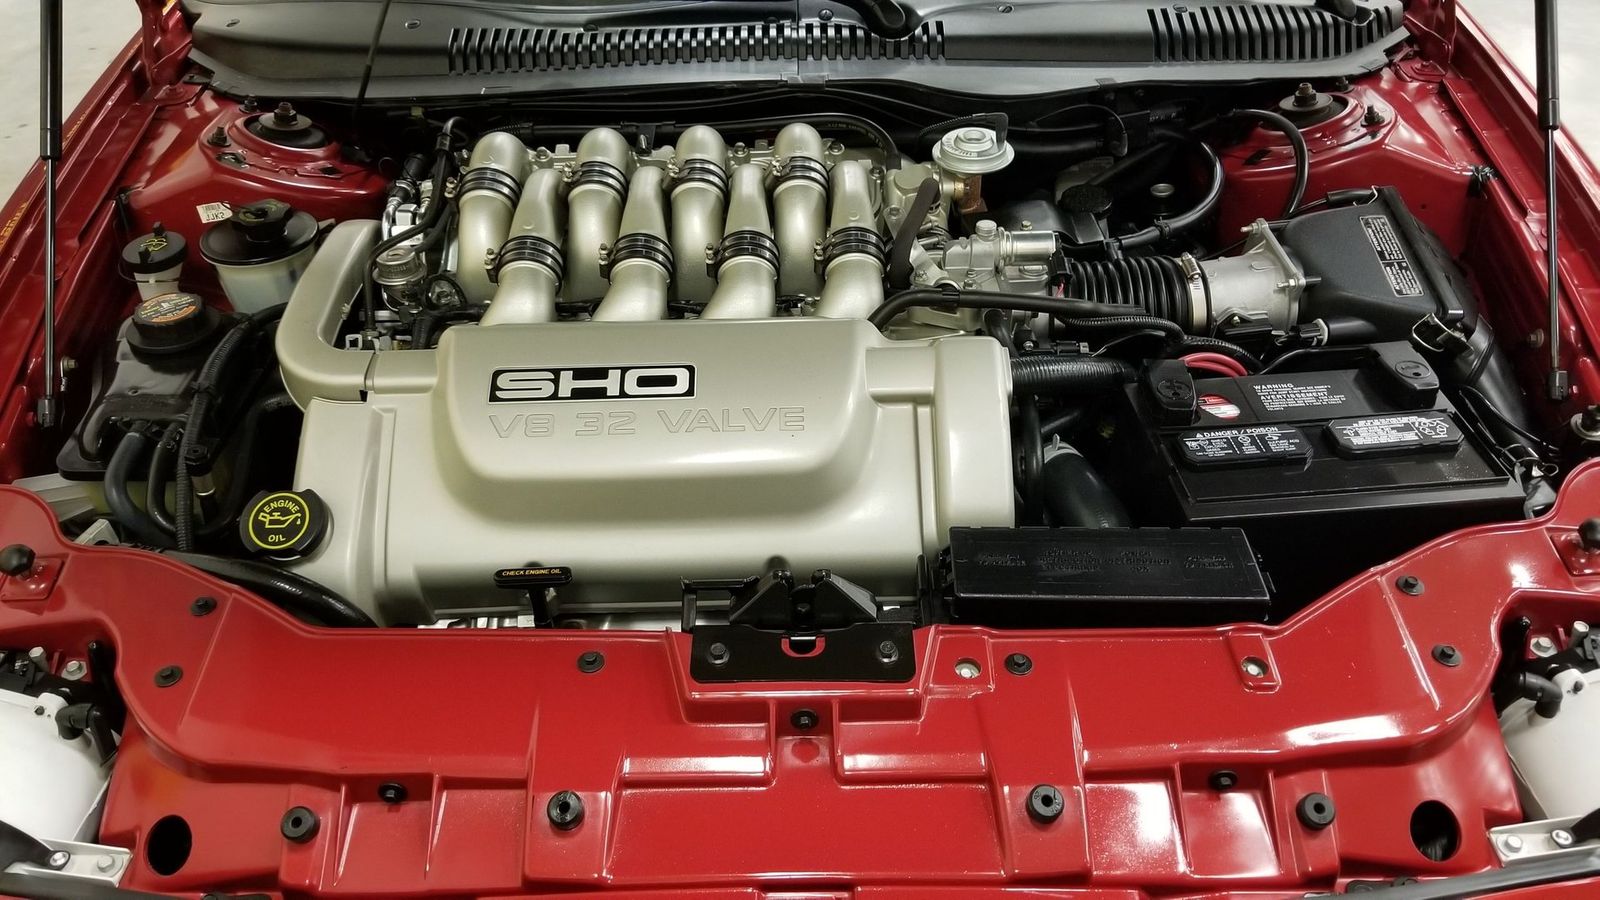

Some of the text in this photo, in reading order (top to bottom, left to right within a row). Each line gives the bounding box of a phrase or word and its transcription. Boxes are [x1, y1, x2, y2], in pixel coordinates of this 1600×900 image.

[495, 367, 690, 399] SHO
[1260, 392, 1328, 400] AVERTISSEMENT
[488, 407, 805, 438] V8 32 VALVE
[1203, 429, 1239, 438] DANGER
[1246, 426, 1279, 434] POISON
[263, 500, 300, 513] ENGINE
[268, 534, 287, 542] OIL
